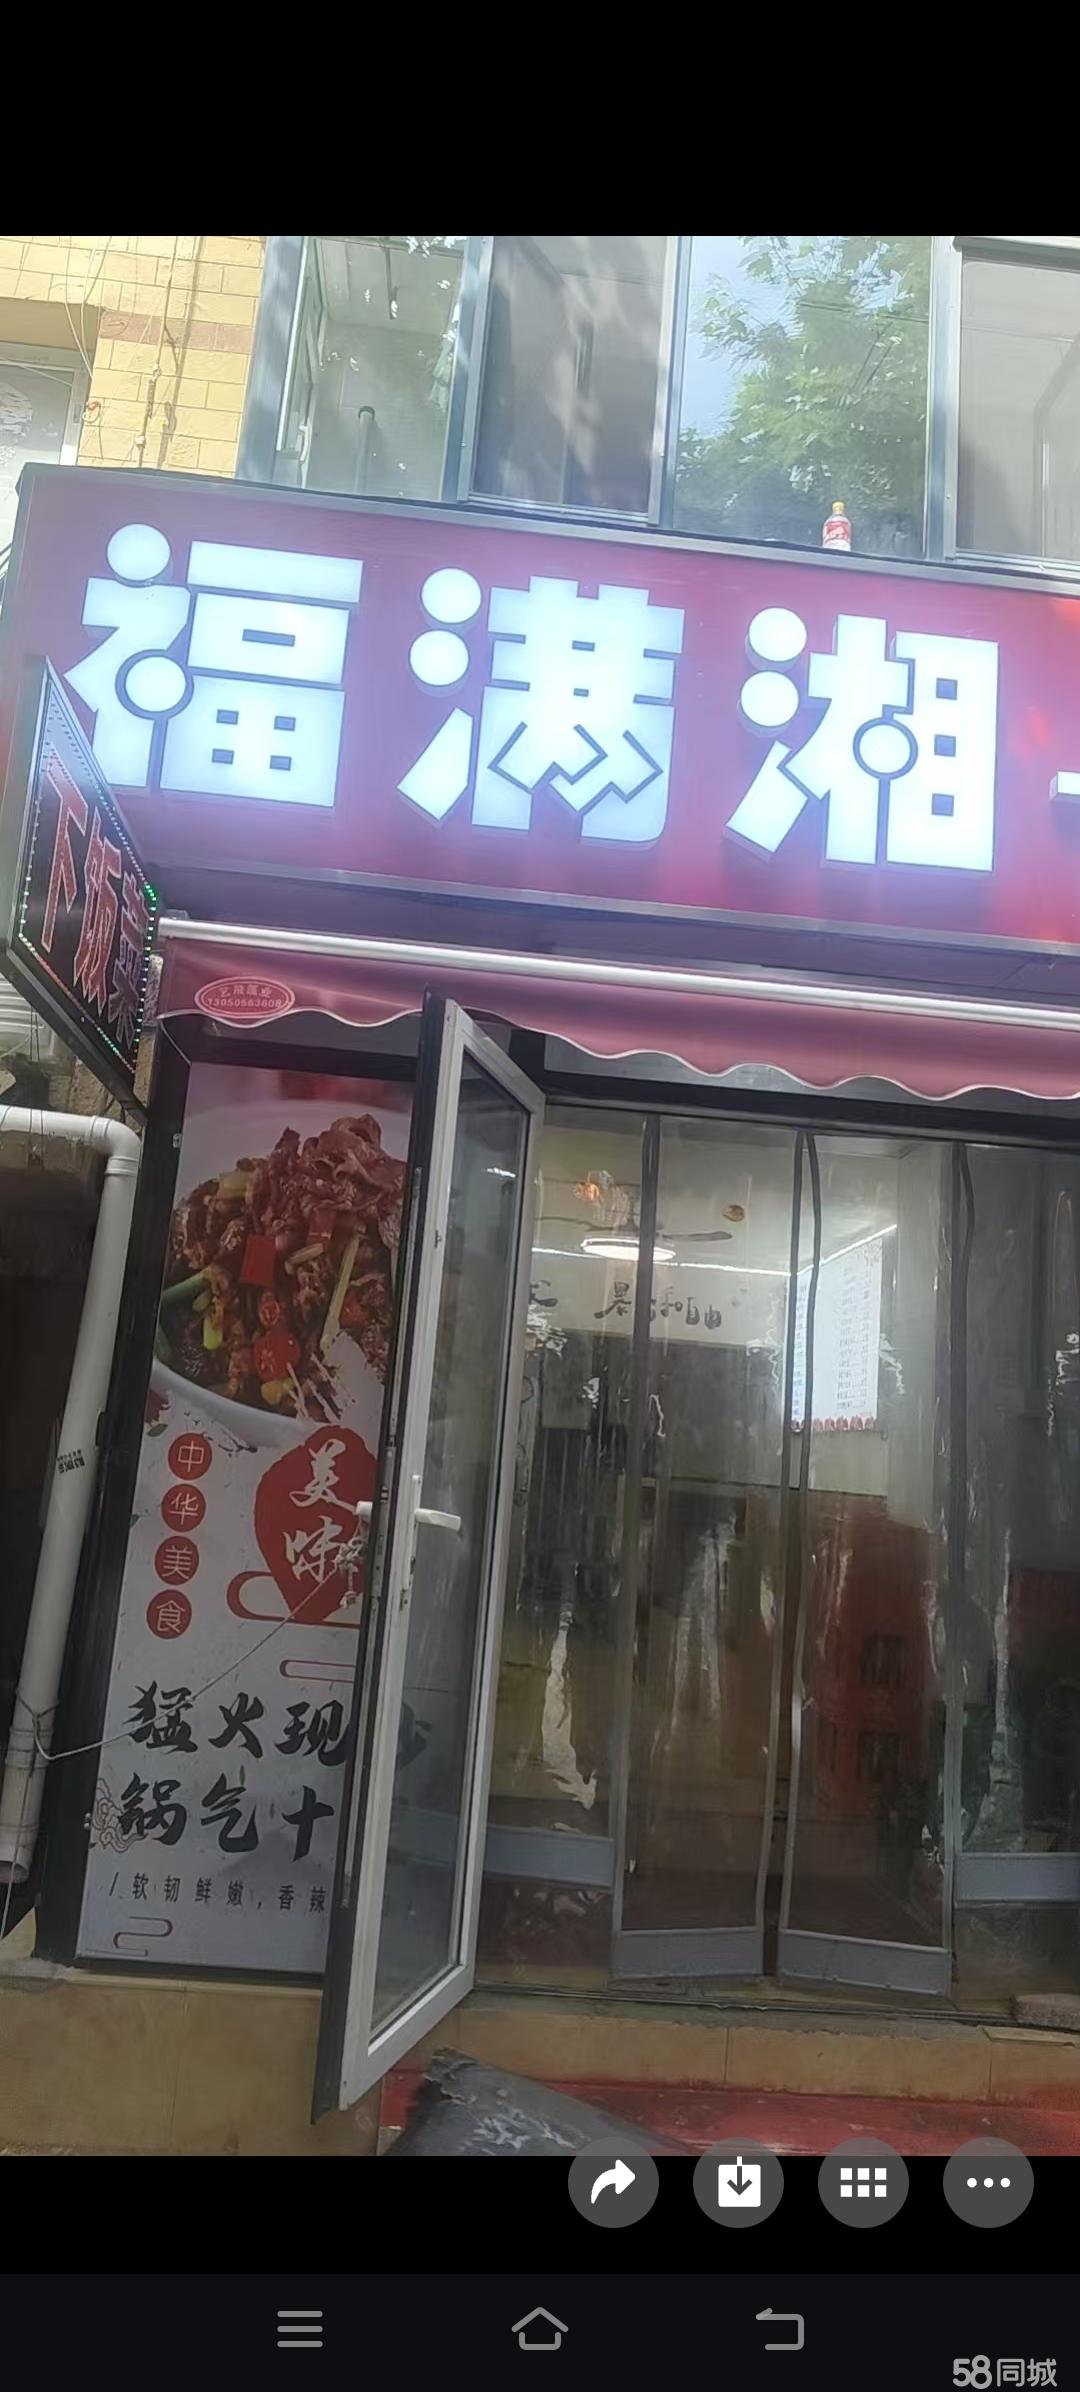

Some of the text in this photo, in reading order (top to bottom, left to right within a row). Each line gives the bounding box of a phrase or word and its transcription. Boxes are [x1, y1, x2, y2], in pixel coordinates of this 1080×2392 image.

[64, 524, 1080, 874] 福满湘
[42, 743, 150, 1049] 下饭菜
[155, 1439, 206, 1635] 中华美食
[282, 1438, 358, 1584] 美味
[117, 1772, 335, 1863] 锅气十
